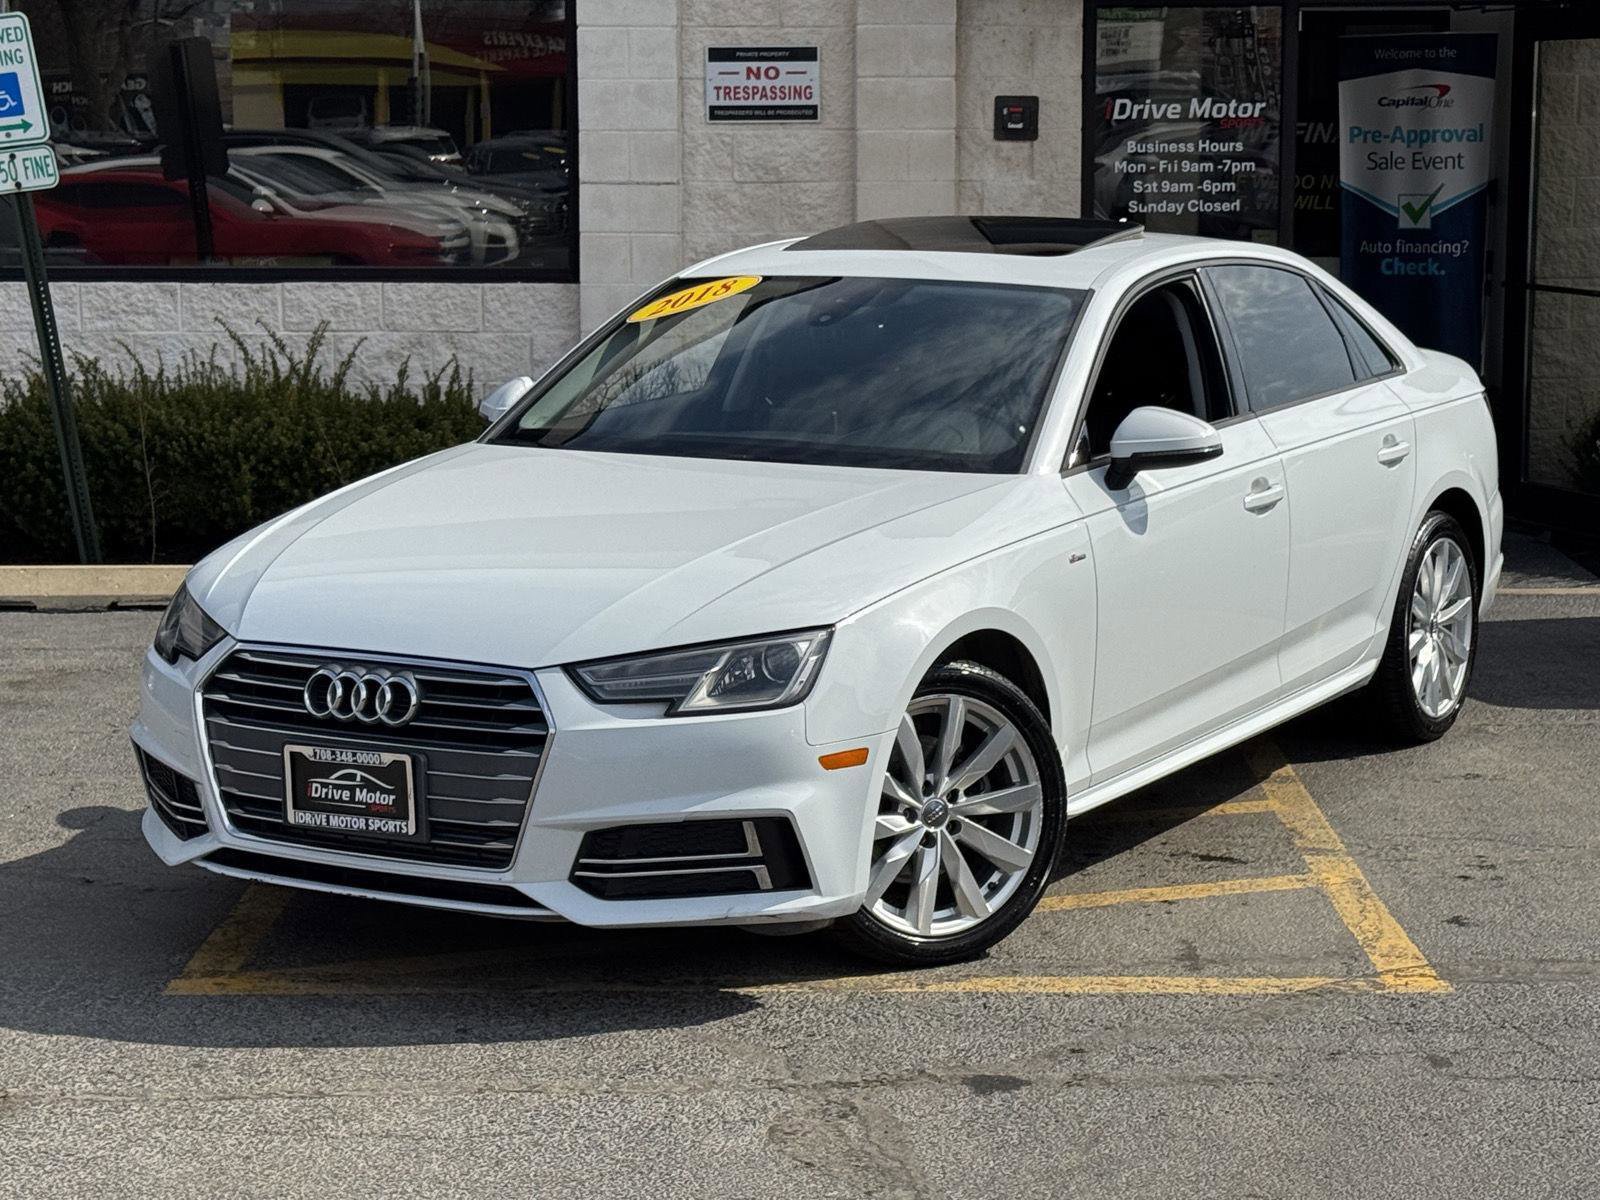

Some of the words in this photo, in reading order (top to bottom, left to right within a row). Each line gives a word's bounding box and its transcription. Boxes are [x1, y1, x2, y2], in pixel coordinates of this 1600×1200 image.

[1374, 48, 1421, 60] Welcome
[1425, 49, 1436, 58] to
[1439, 47, 1457, 58] the
[746, 66, 780, 81] NO
[713, 85, 813, 101] TRESPASSING
[1188, 97, 1267, 119] Motor
[1349, 123, 1484, 148] Pre-Approval
[1127, 141, 1194, 153] Business
[1198, 140, 1243, 153] Hours
[22, 155, 54, 180] FINE
[1114, 161, 1146, 173] Mon
[1159, 160, 1178, 173] Fri
[1181, 161, 1214, 173] 9am
[1217, 160, 1256, 175] -7pm
[1366, 150, 1406, 171] Sale
[1411, 151, 1464, 171] Event
[1133, 181, 1159, 193] Sat
[1161, 181, 1193, 193] 9am
[1197, 180, 1236, 195] -6pm
[1128, 201, 1185, 215] Sunday
[1187, 199, 1241, 212] Closed
[1360, 240, 1392, 254] Auto
[1396, 240, 1470, 257] financing?
[1380, 258, 1446, 276] Check.
[647, 280, 738, 318] 2018
[314, 748, 380, 765] 708-348-0000
[355, 787, 396, 806] Motor
[329, 815, 366, 830] MOTOR
[368, 819, 408, 834] SPORTS
